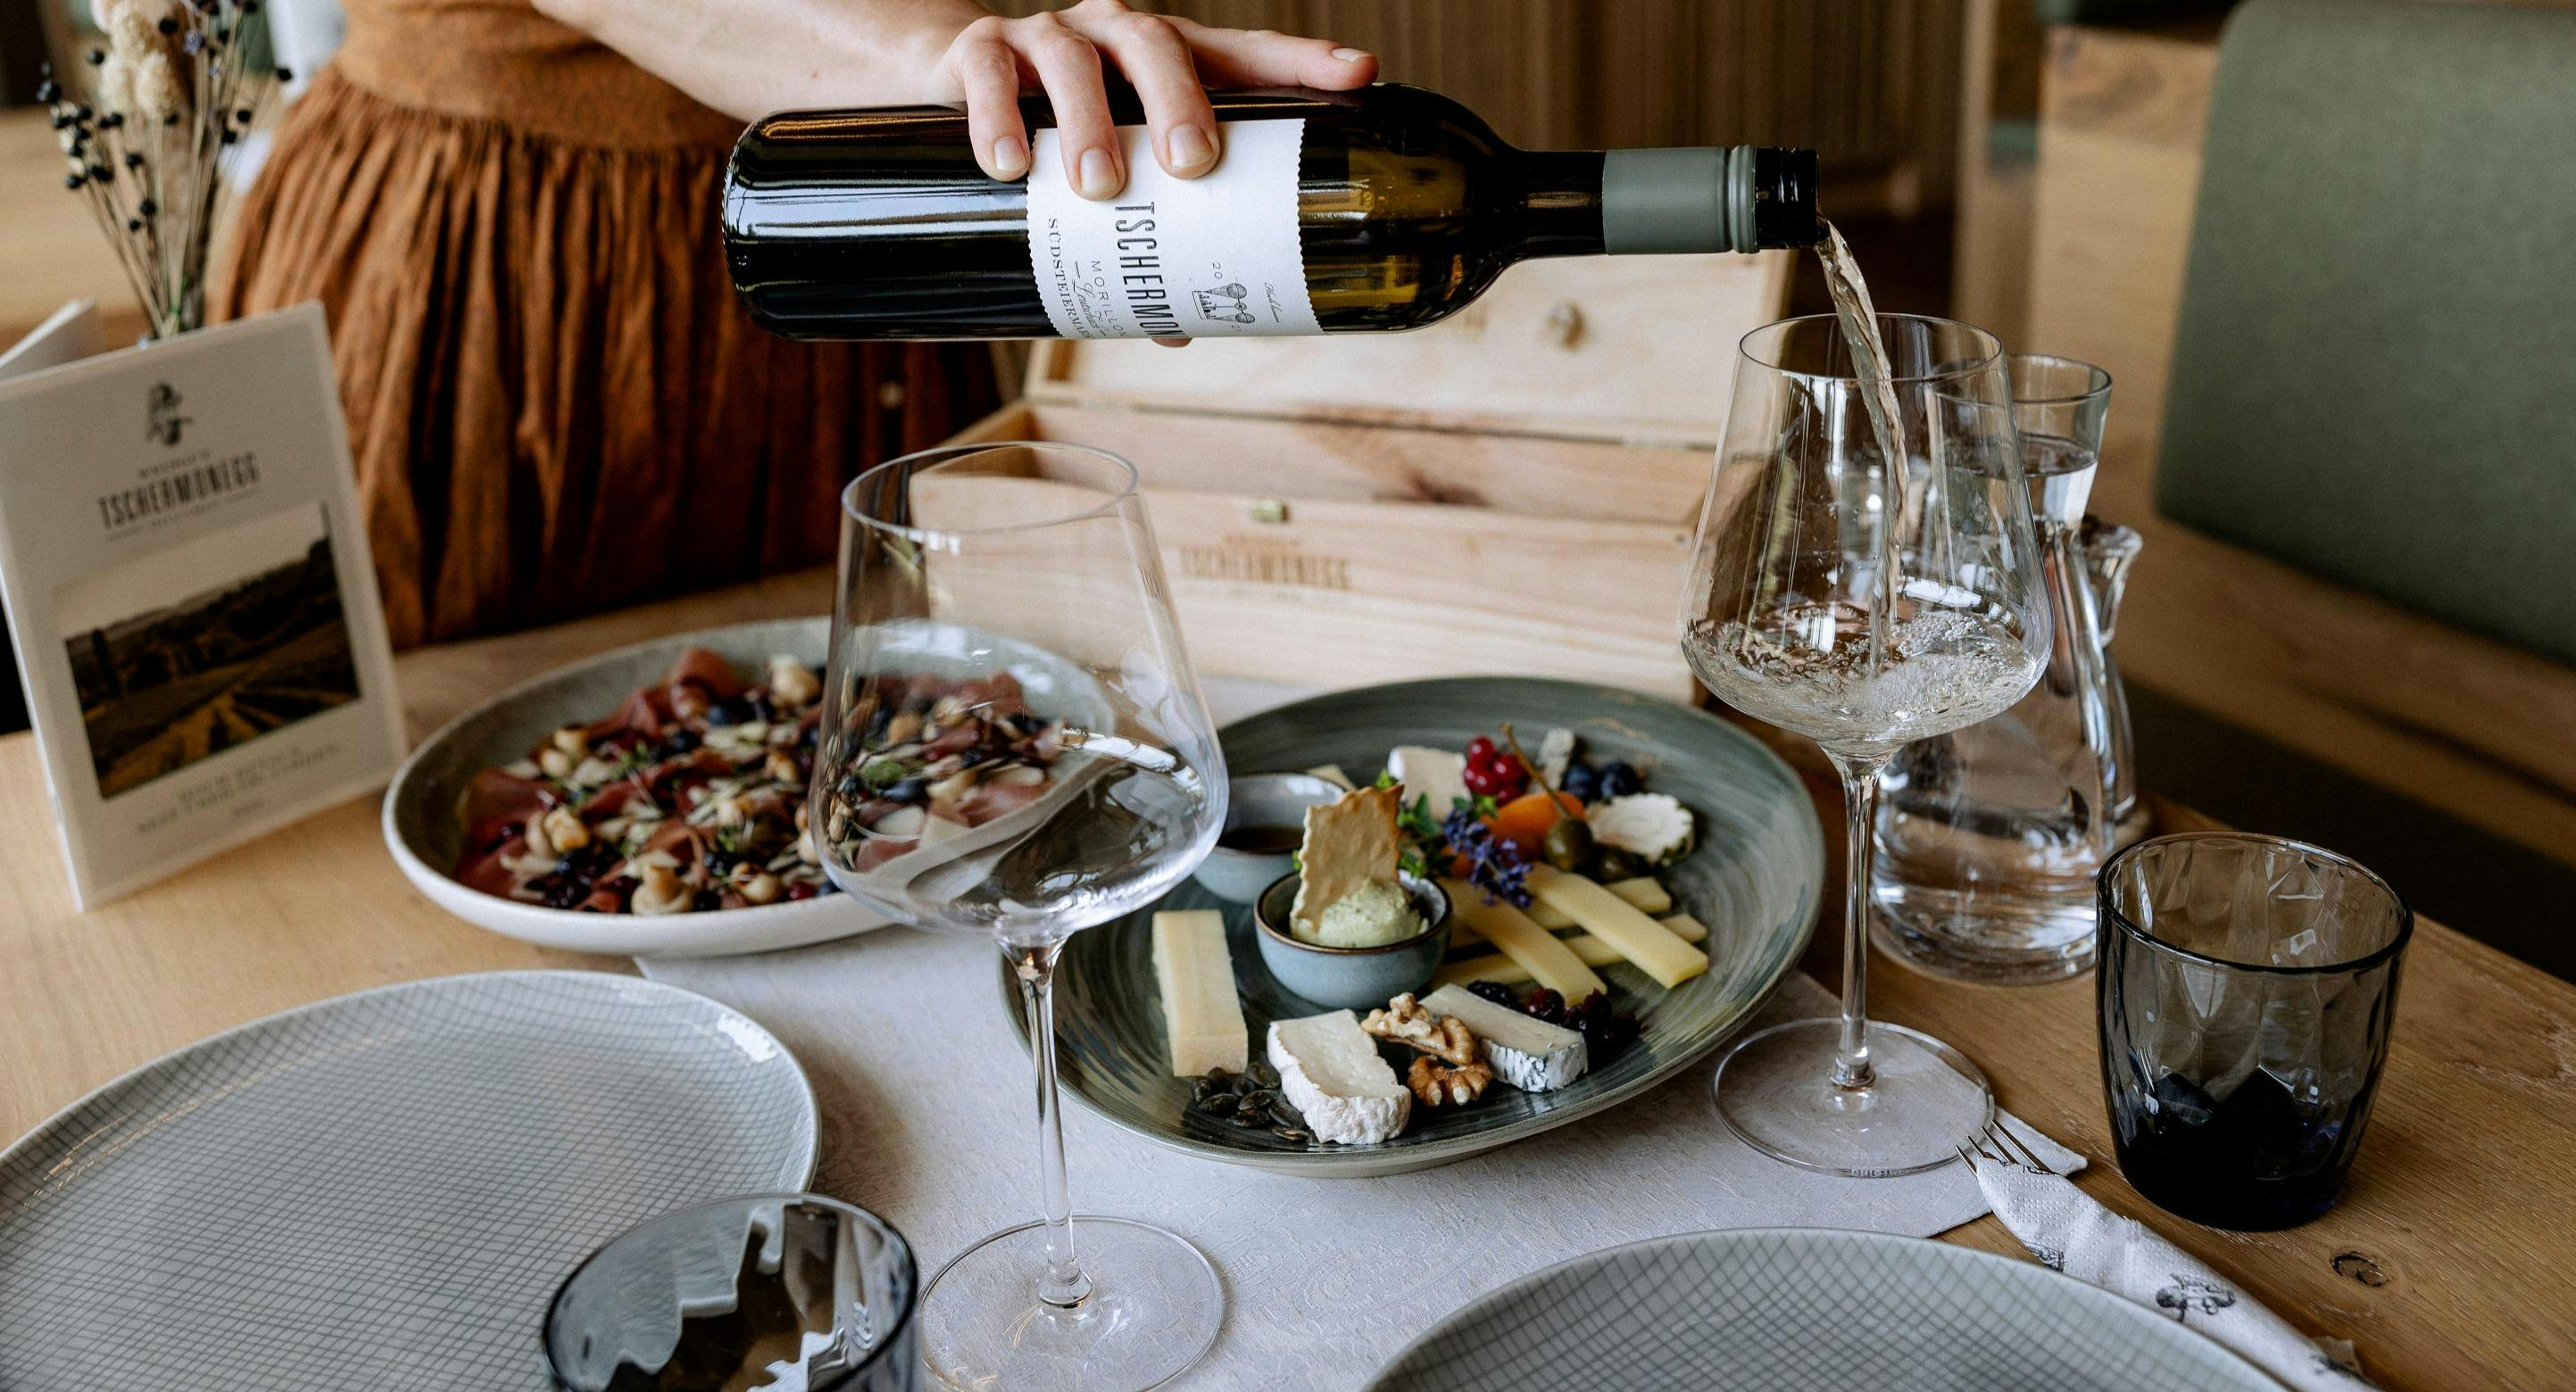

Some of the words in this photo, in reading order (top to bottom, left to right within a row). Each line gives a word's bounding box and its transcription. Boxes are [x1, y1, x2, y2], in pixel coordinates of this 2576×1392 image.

[1091, 260, 1127, 336] MORILLON
[1114, 201, 1189, 337] TSCHERMON
[1212, 261, 1223, 279] 20
